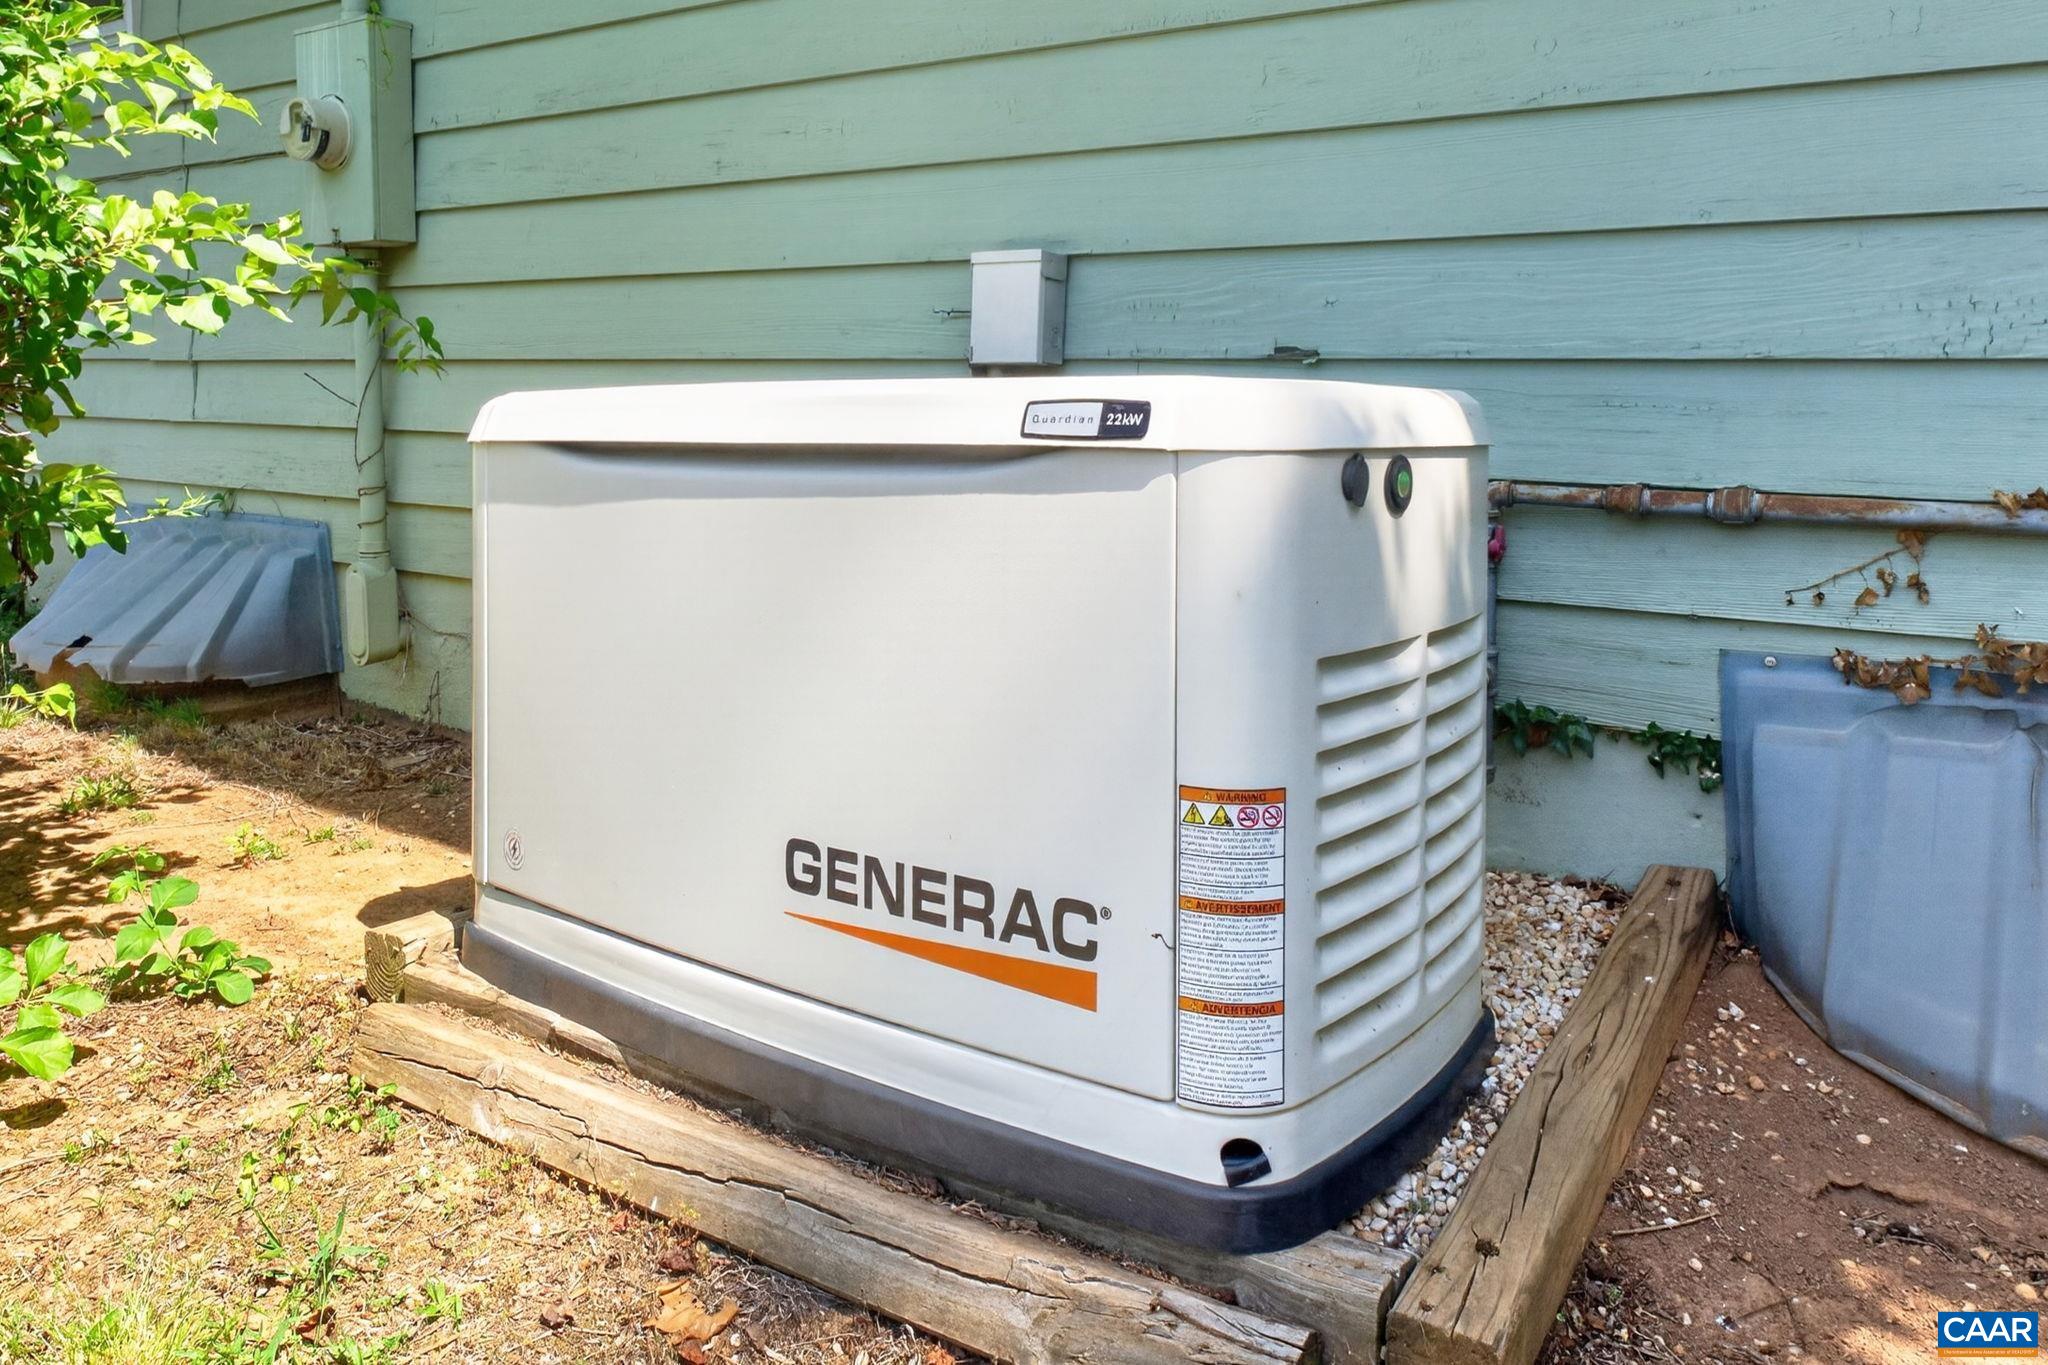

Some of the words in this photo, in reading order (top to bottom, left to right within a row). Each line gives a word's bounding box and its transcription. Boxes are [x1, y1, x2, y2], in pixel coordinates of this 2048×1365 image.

[1032, 414, 1094, 424] Guardian
[1106, 413, 1144, 426] 22kW
[1215, 792, 1267, 803] WARNING
[1196, 901, 1281, 914] AVERTISSEMENT
[1202, 1003, 1276, 1015] ADVERTENCIA
